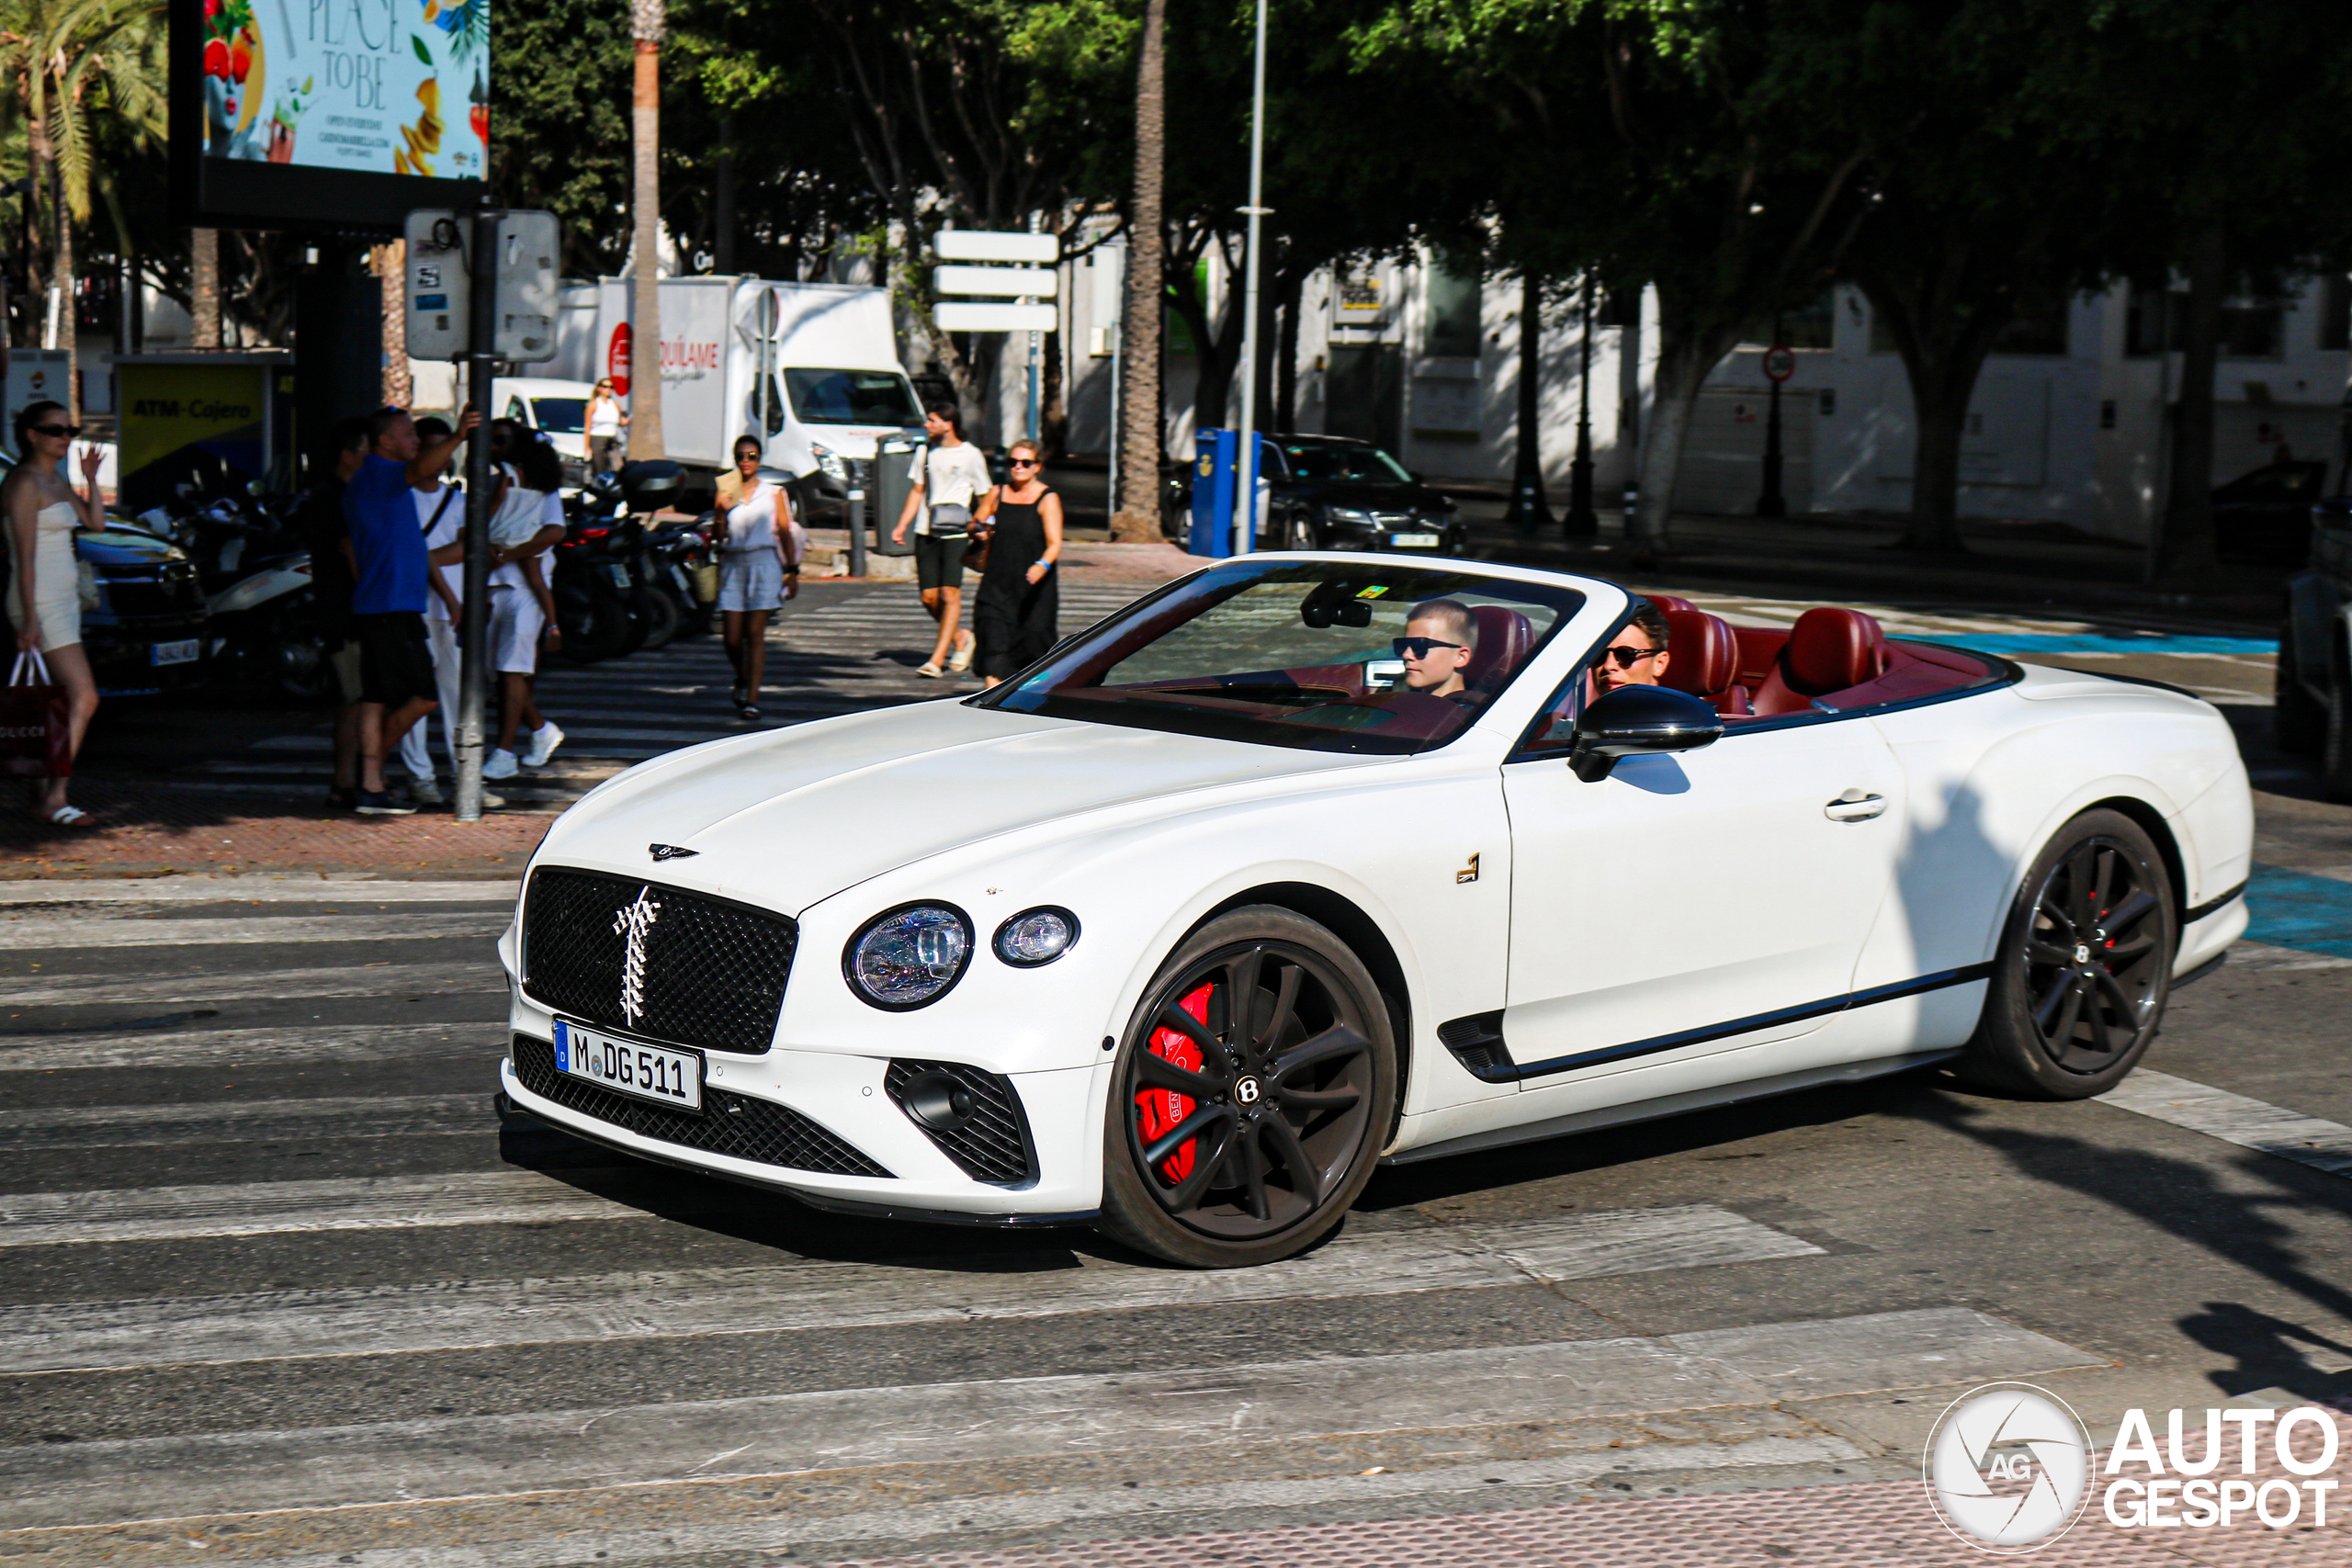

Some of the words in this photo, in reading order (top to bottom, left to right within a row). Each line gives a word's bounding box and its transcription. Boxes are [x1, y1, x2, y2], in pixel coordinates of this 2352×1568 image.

[309, 0, 402, 53] PLACE
[659, 334, 718, 369] QUÍLAME
[574, 1032, 590, 1072] M
[603, 1041, 633, 1086] DG
[638, 1051, 686, 1099] 511
[1239, 1079, 1259, 1101] B
